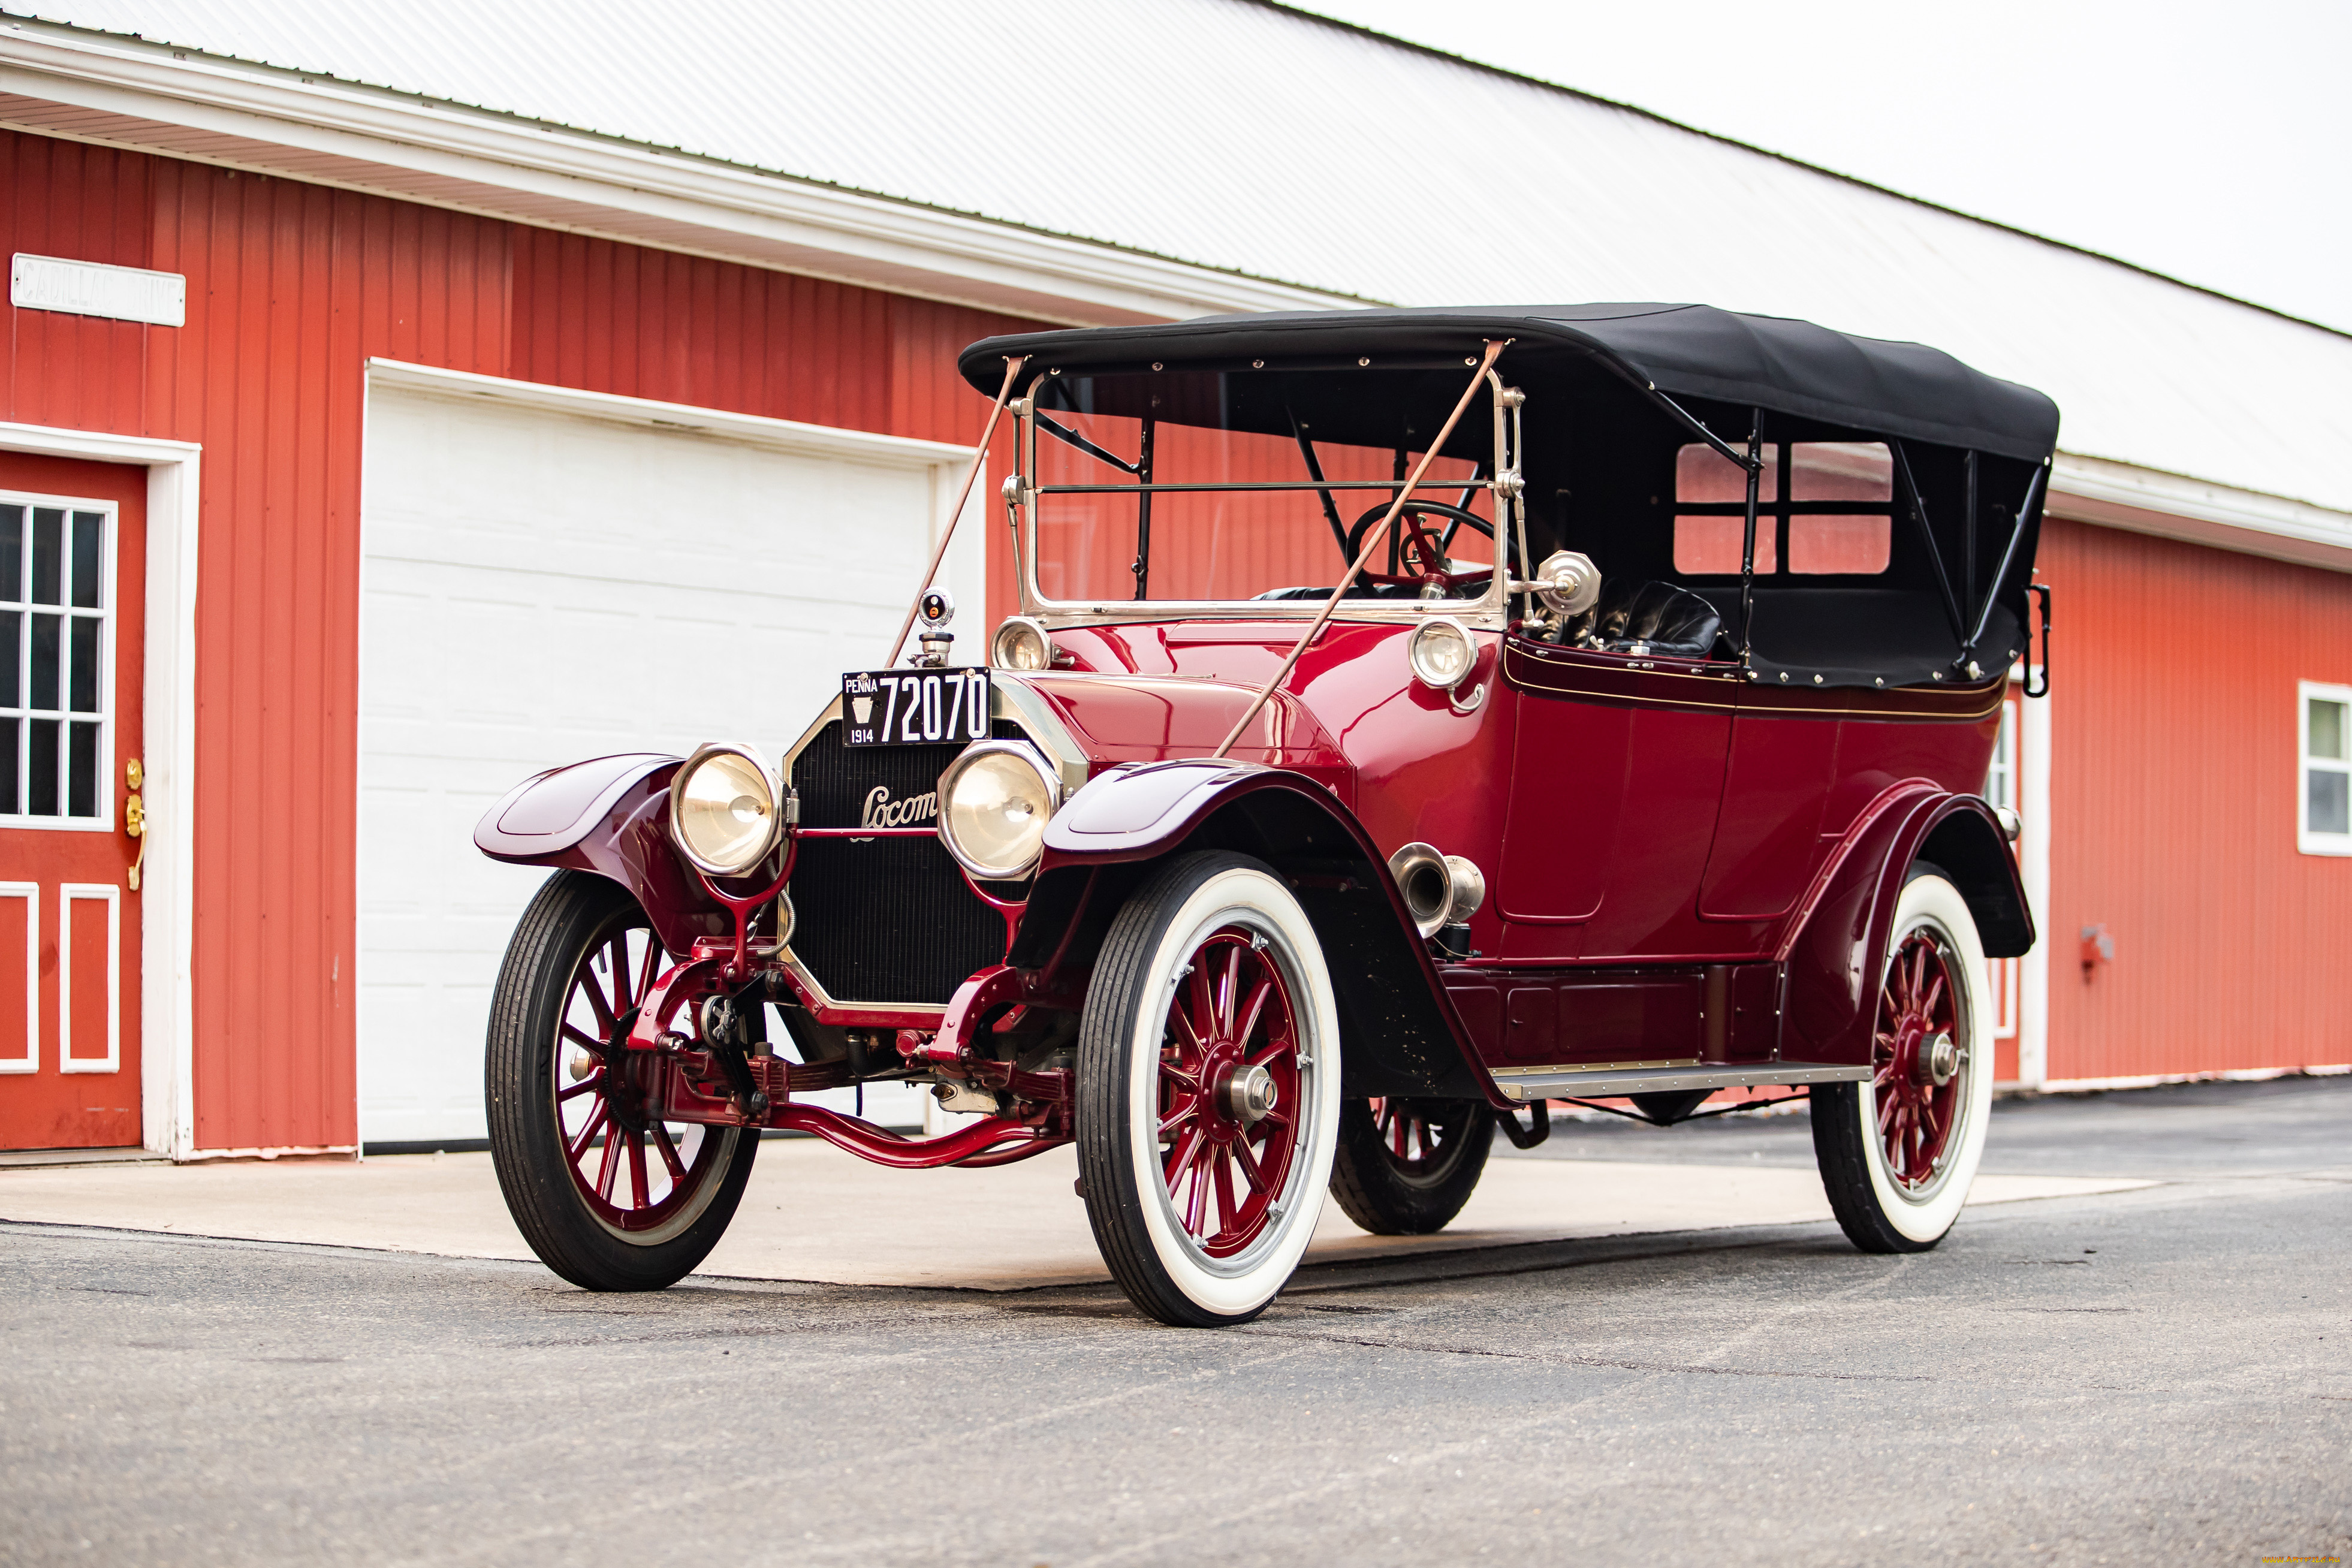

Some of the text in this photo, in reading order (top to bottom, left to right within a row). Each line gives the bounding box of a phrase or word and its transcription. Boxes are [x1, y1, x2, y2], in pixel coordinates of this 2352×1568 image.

[23, 261, 177, 318] CADILLAC DRIVE
[846, 679, 878, 693] PENNA
[879, 674, 987, 742] 72070
[851, 729, 874, 743] 1914
[850, 786, 937, 842] Locom
